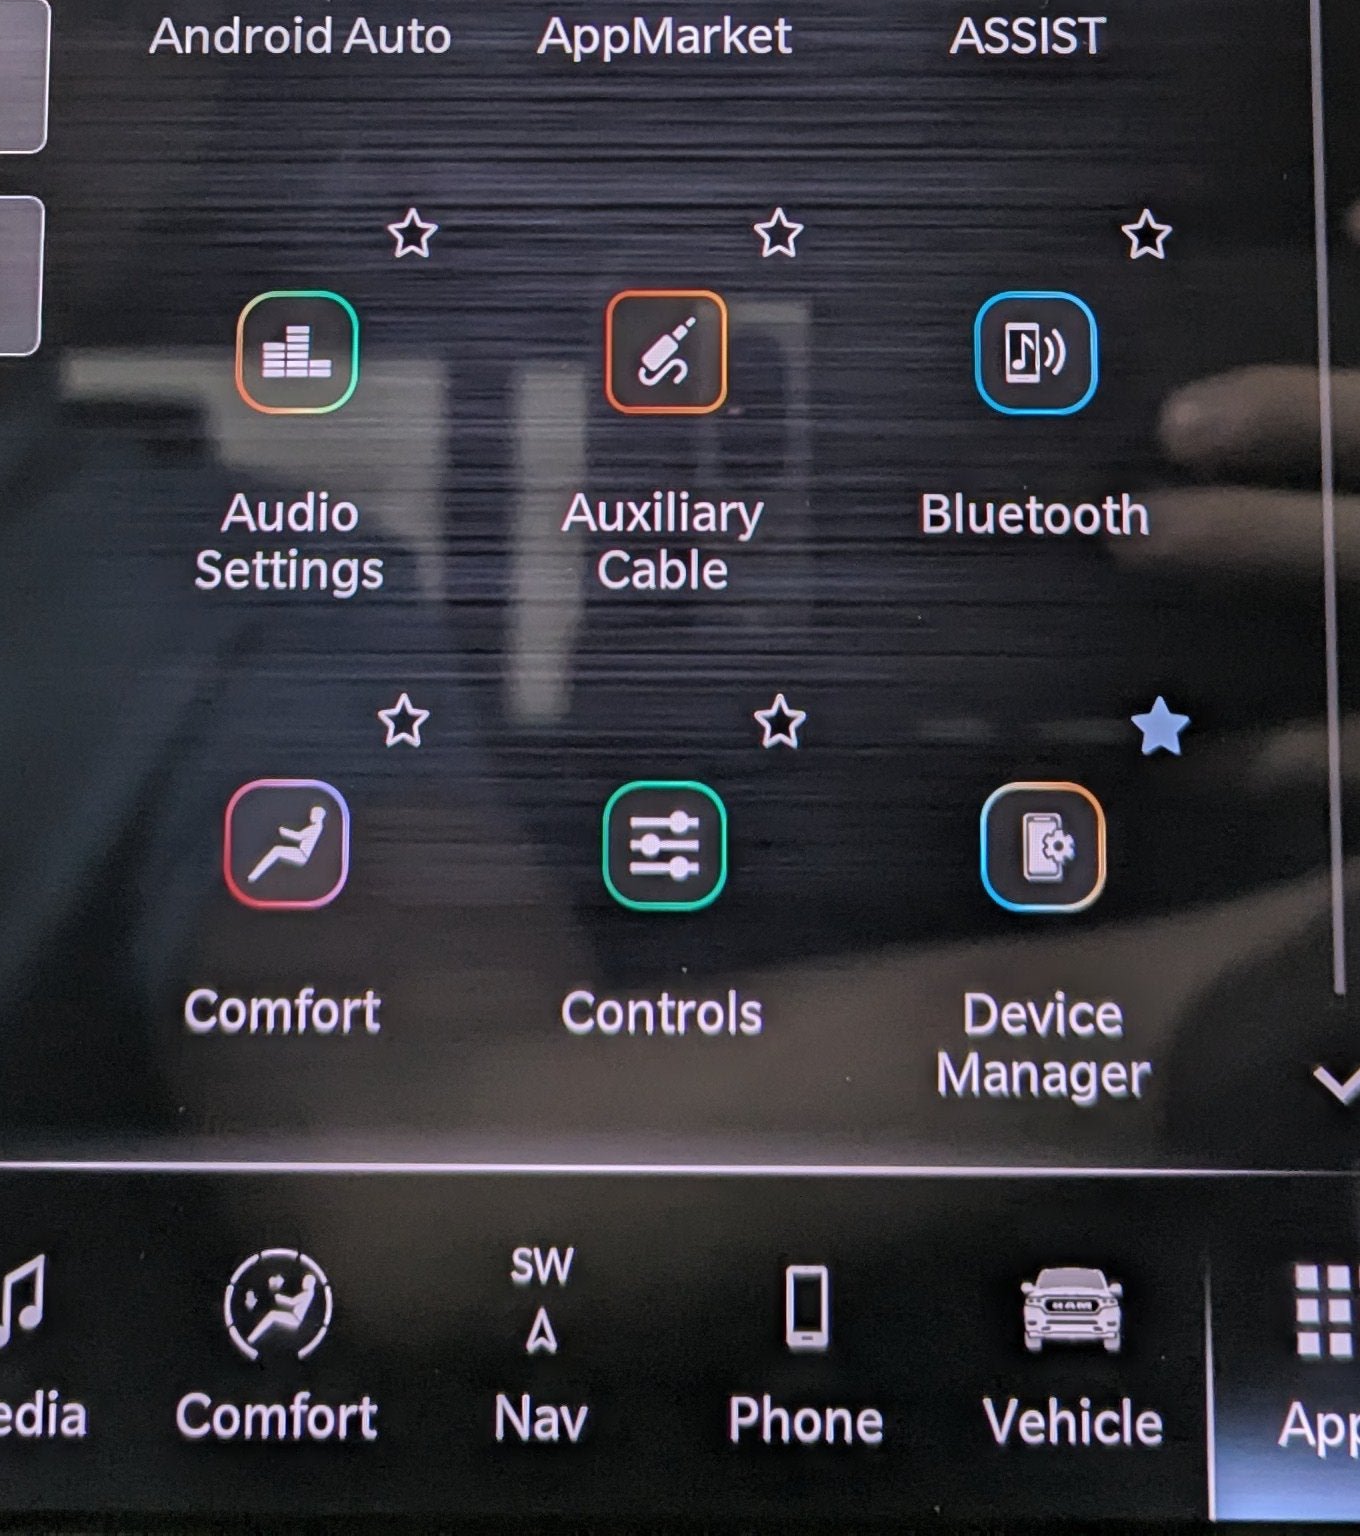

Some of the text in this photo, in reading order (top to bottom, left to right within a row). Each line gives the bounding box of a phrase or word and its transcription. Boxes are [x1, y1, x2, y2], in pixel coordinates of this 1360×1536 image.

[148, 15, 451, 54] Android Auto
[536, 15, 793, 63] AppMarket
[949, 16, 1107, 55] ASSIST
[220, 491, 359, 532] Audio
[560, 490, 765, 542] Auxiliary
[922, 492, 1149, 536] Bluetooth
[195, 548, 384, 599] Settings
[598, 548, 728, 590] Cable
[184, 987, 382, 1034] Comfort
[562, 989, 762, 1035] Controls
[964, 990, 1122, 1036] Device
[937, 1051, 1151, 1105] Manager
[510, 1246, 574, 1285] SW
[176, 1391, 378, 1440] Comfort
[495, 1393, 589, 1442] Nav
[730, 1394, 883, 1444] Phone
[982, 1396, 1163, 1446] Vehicle
